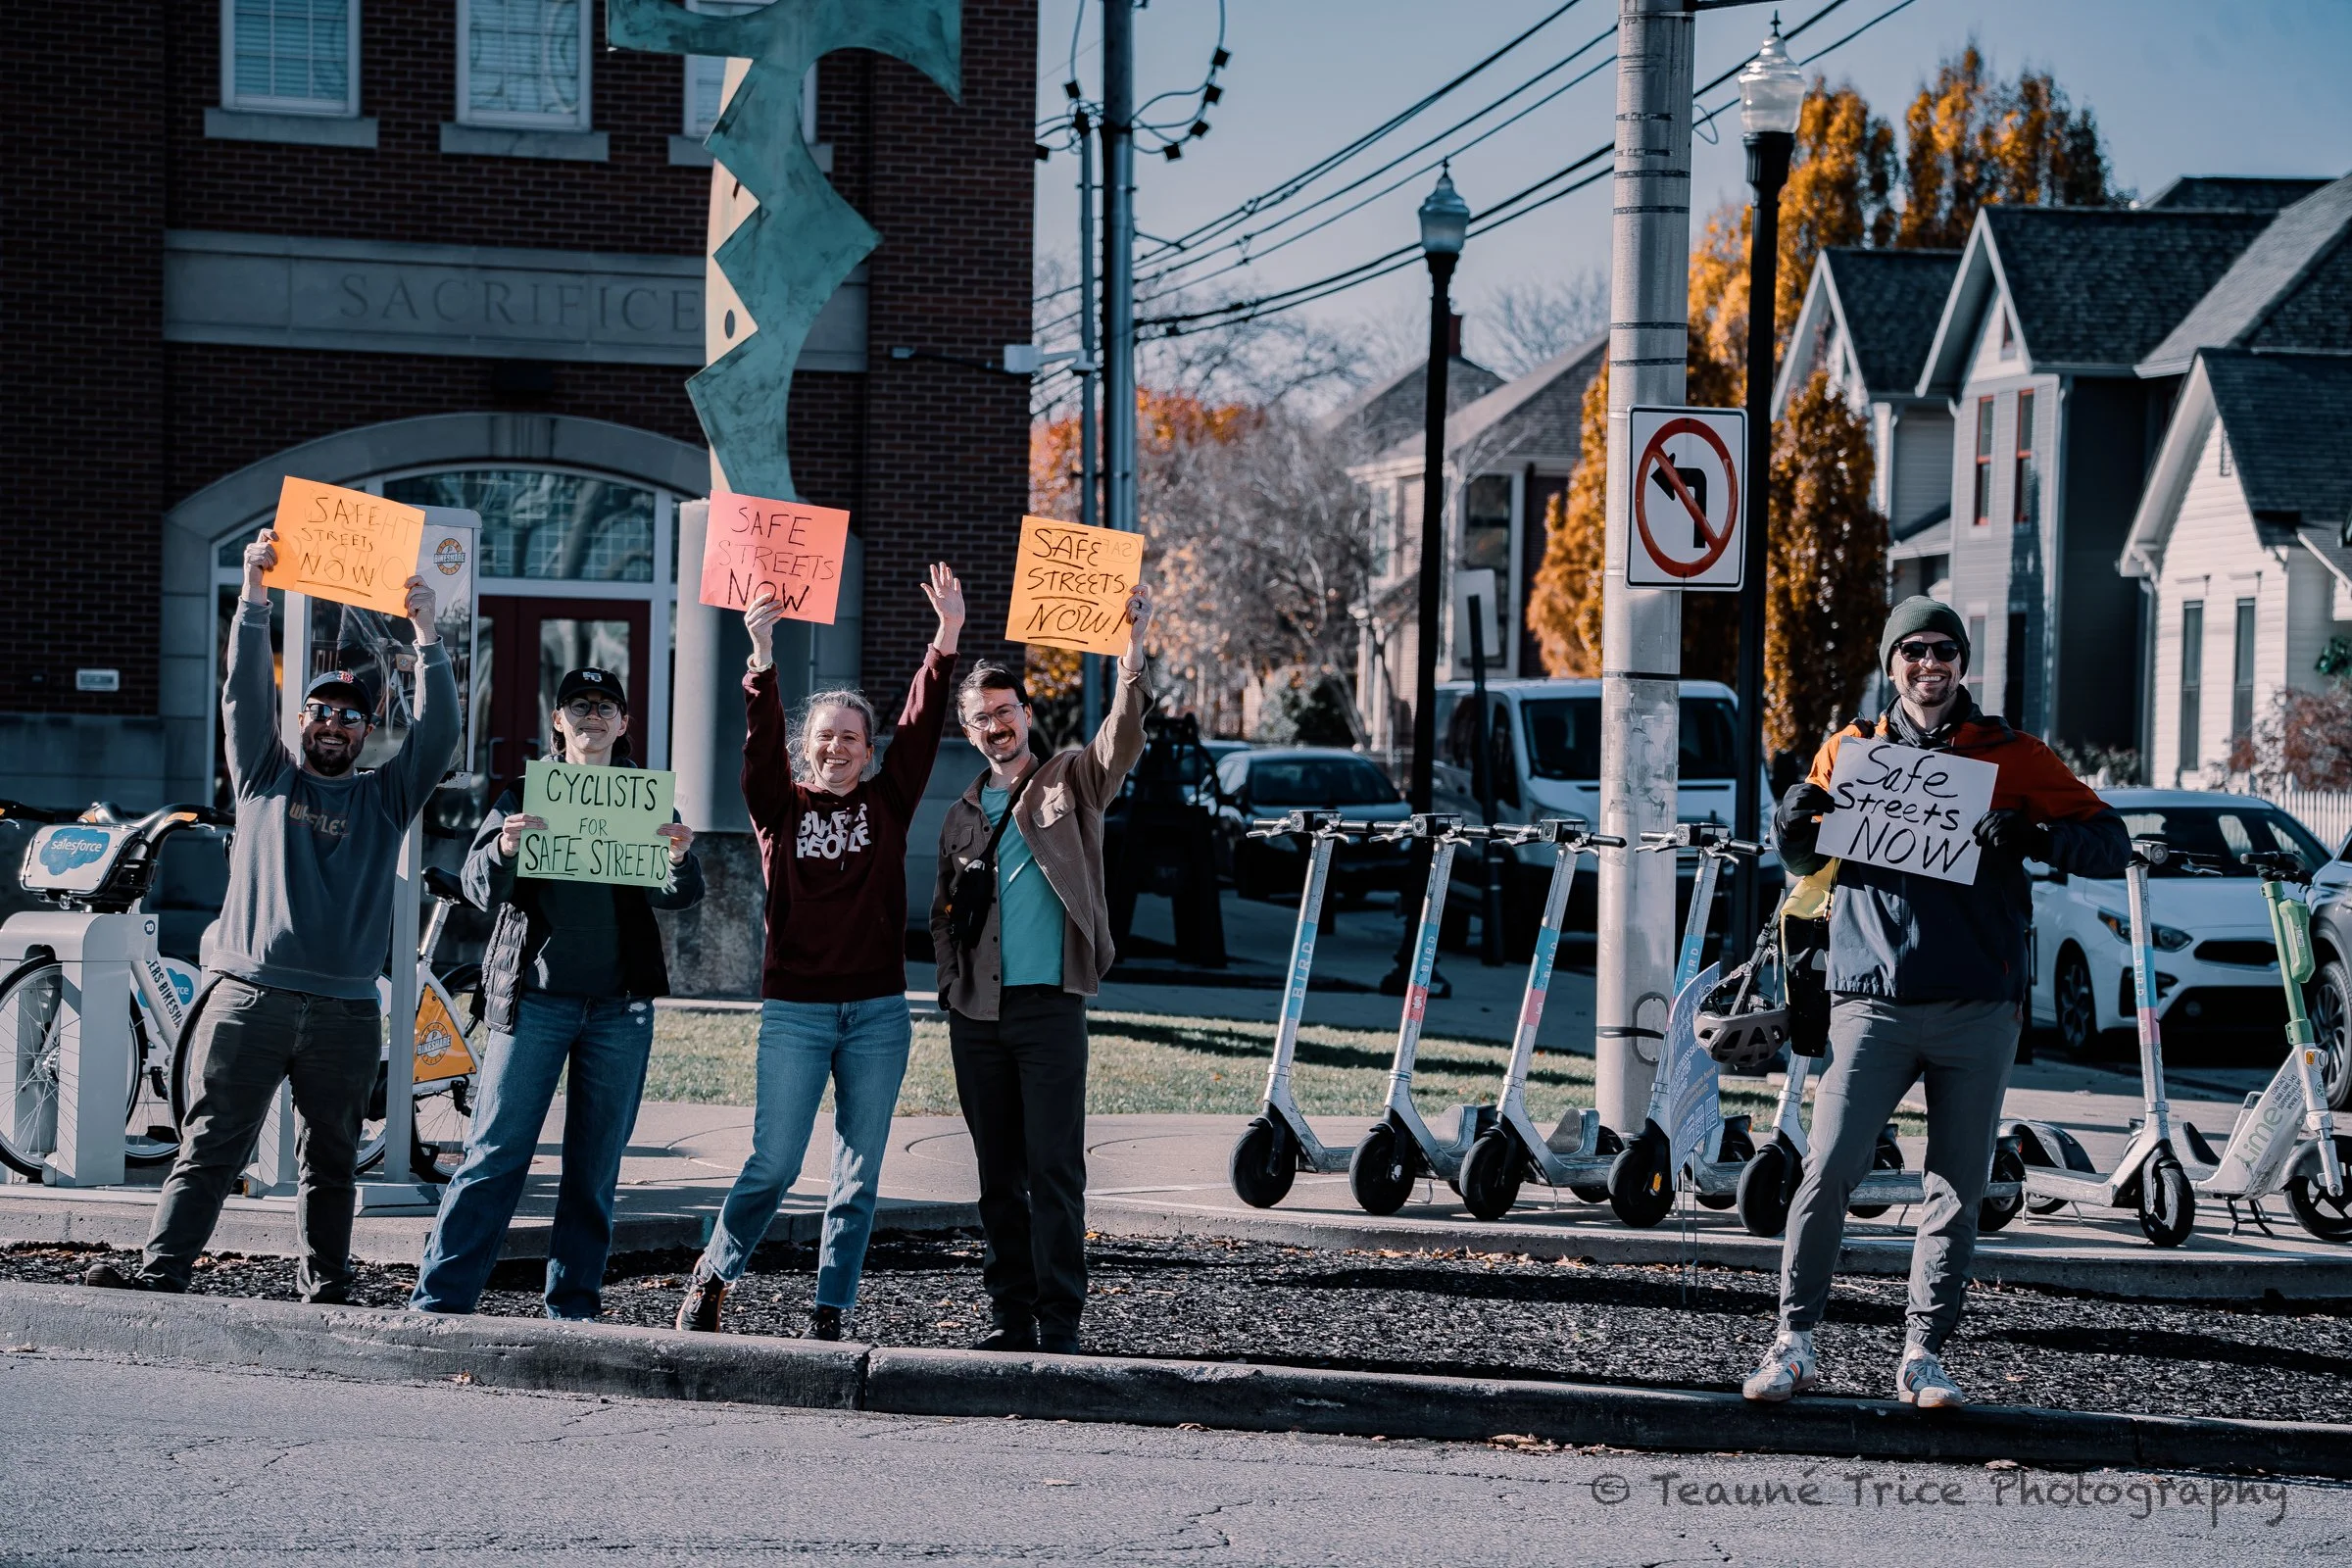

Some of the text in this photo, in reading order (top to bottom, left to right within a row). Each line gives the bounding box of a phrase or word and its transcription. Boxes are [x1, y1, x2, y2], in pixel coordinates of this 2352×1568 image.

[339, 272, 701, 333] SACRIFICE
[308, 497, 381, 526] SAFE
[730, 507, 812, 546] SAFE
[718, 540, 835, 580] STREETS
[1032, 528, 1102, 566] SAFE
[300, 553, 375, 587] NOW
[727, 567, 810, 612] NOW
[1026, 566, 1126, 595] STREETS
[546, 768, 658, 811] CYCLISTS
[1855, 745, 1959, 799] Safe
[1834, 782, 1961, 831] Streets
[578, 817, 609, 836] FOR
[796, 821, 872, 859] PEOPLE
[1847, 815, 1972, 874] NOW
[50, 837, 103, 856] salesforce
[524, 833, 669, 881] SAFE STREETS
[145, 922, 155, 932] 10
[1291, 941, 1314, 999] BIRD
[1421, 935, 1436, 973] BIRD
[2134, 958, 2145, 997] BIRD
[416, 1035, 452, 1055] BIKESHARE
[2233, 1106, 2284, 1164] Lime
